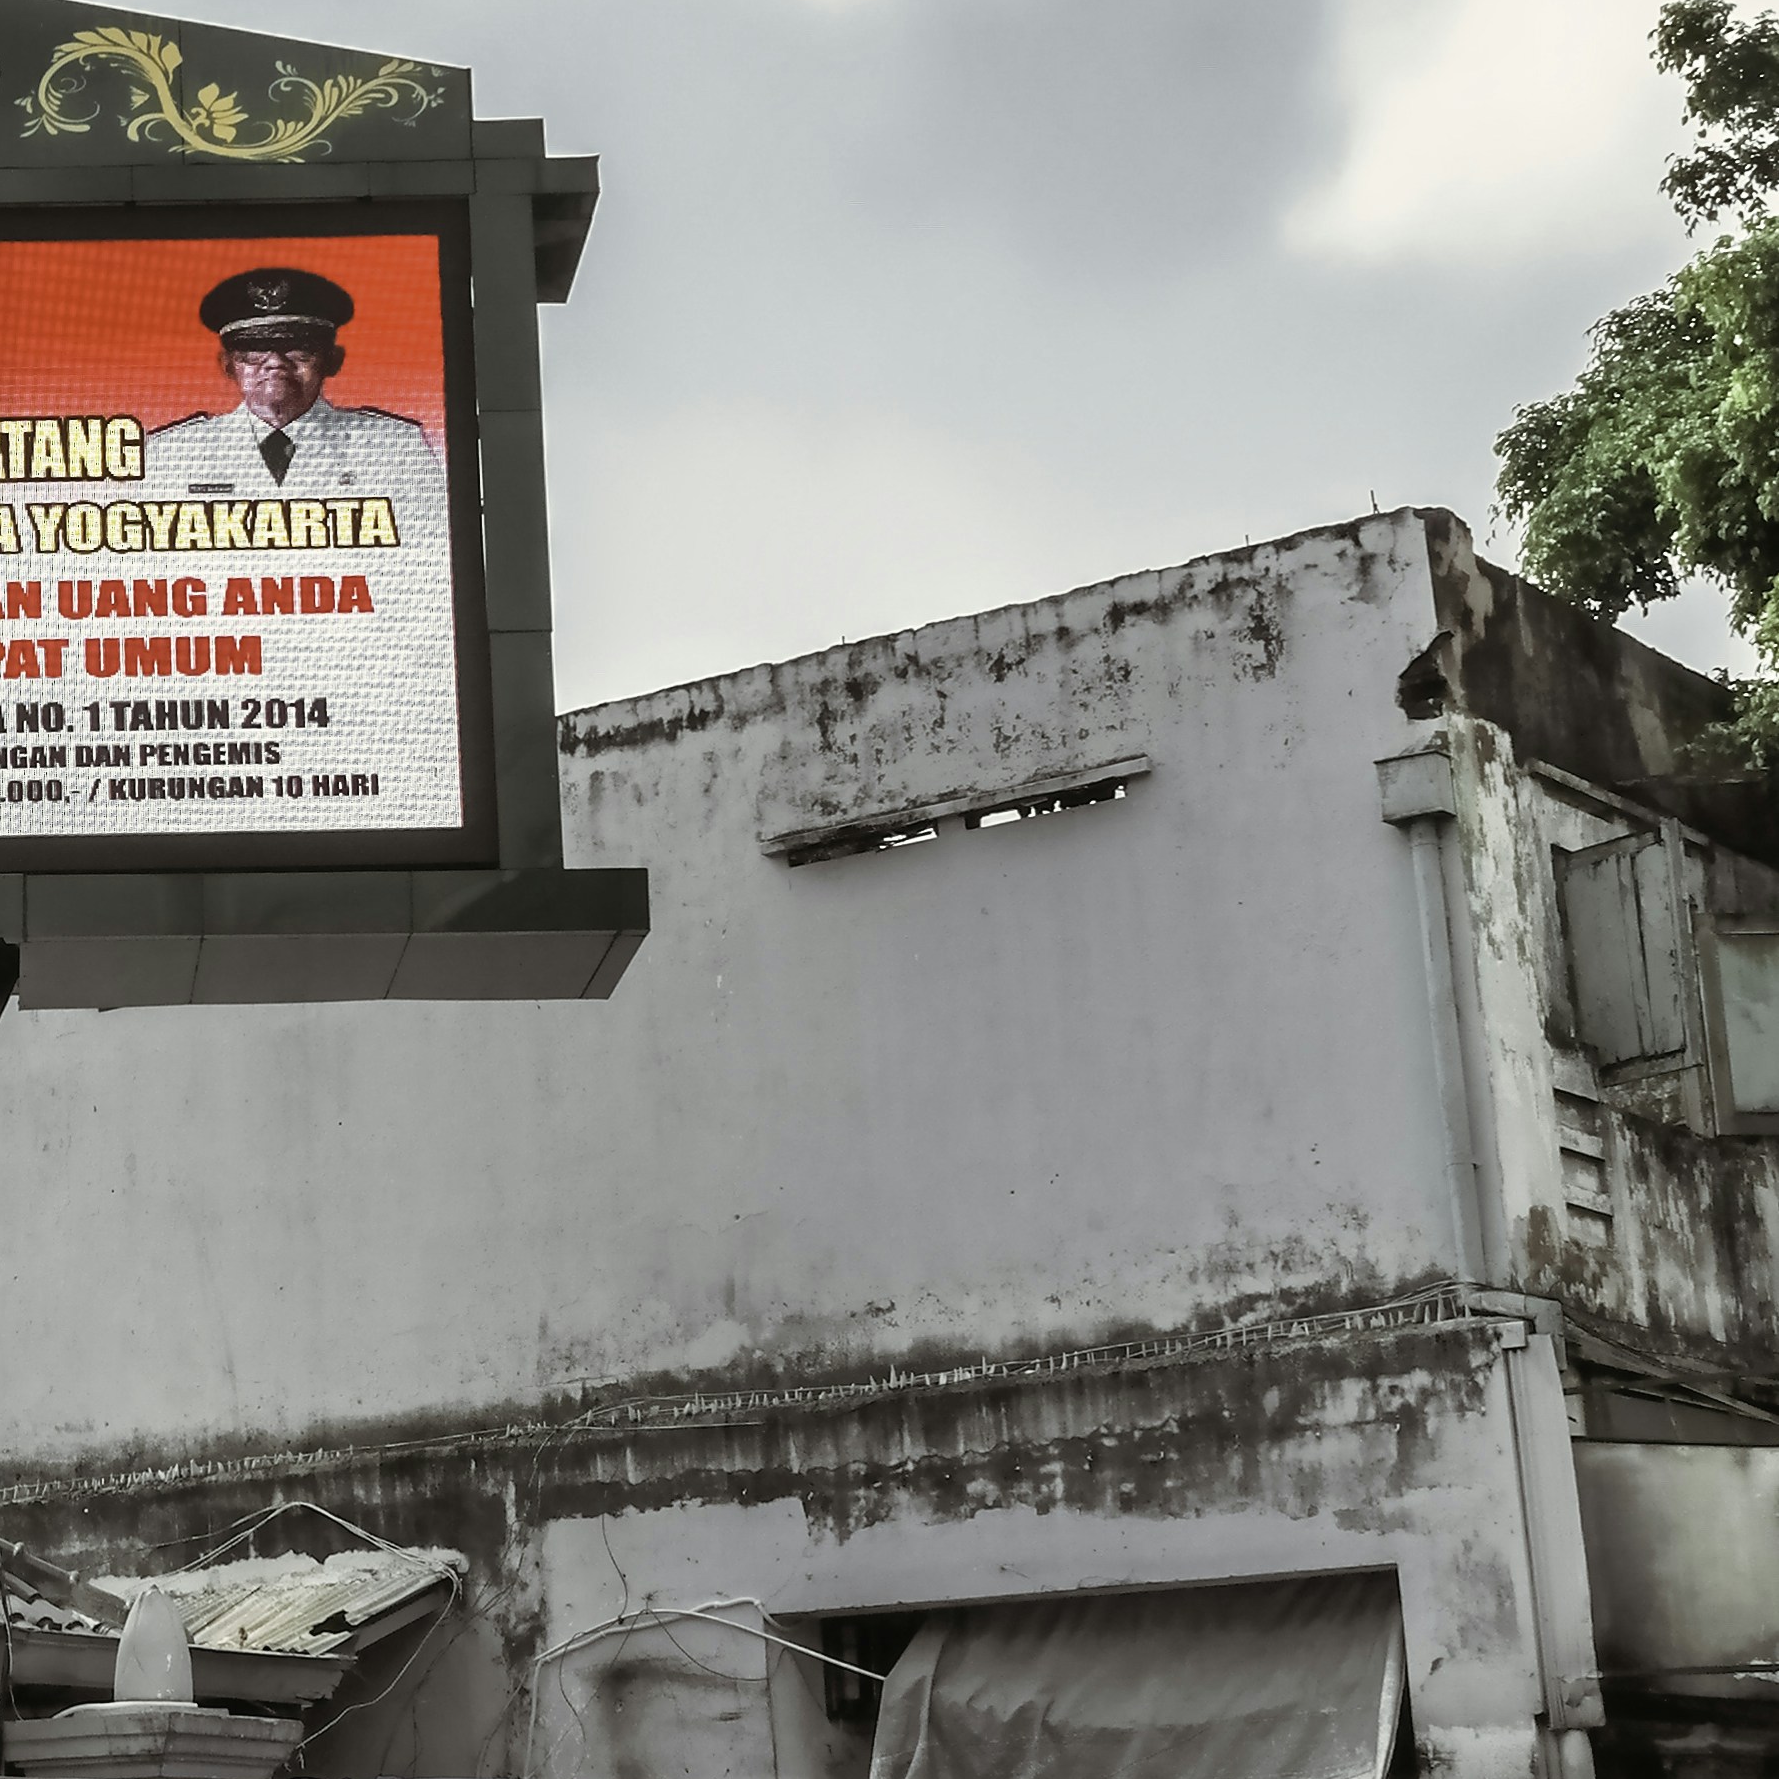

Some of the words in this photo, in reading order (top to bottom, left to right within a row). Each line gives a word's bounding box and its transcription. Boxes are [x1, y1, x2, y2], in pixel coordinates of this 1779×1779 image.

[25, 496, 401, 554] YOGYAKARTA
[57, 576, 208, 620] UANG
[221, 574, 375, 616] ANDA
[84, 635, 263, 677] UMUM
[15, 701, 74, 734] NO.
[108, 698, 231, 732] TAHUN
[241, 697, 331, 730] 2014
[75, 744, 132, 769] DAN
[139, 741, 282, 767] PENGEMIS
[108, 774, 265, 801] KURUNGAN
[271, 775, 304, 799] 10
[312, 772, 381, 798] HARI
